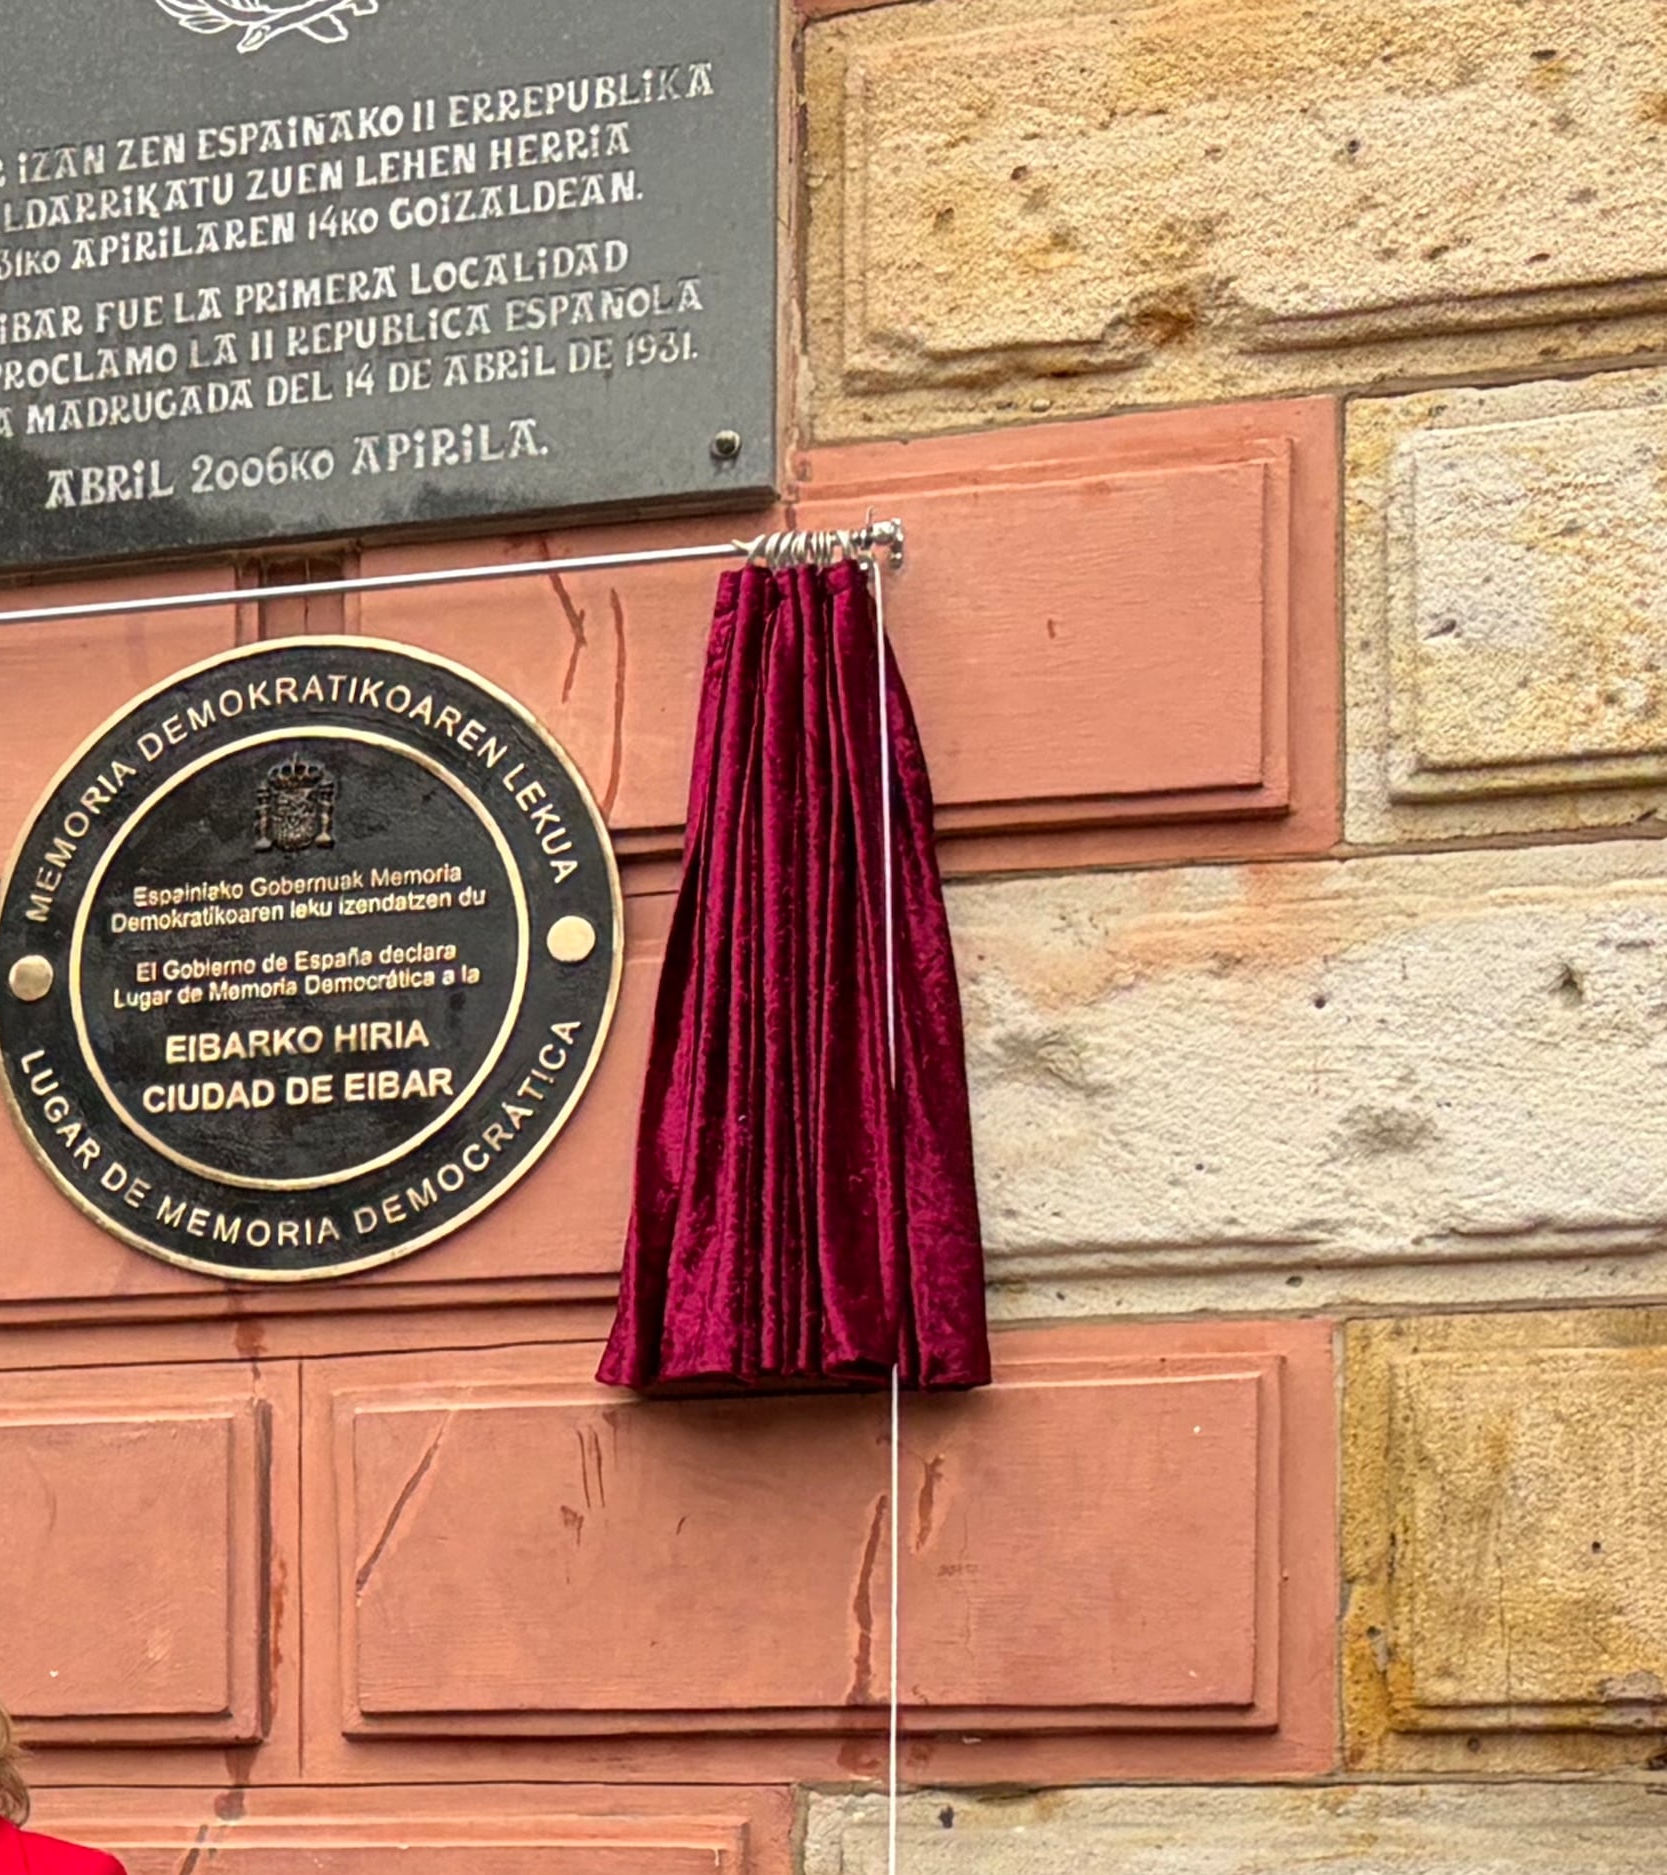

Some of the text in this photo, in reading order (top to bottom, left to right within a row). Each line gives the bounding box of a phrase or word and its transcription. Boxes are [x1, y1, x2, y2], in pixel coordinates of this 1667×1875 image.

[117, 132, 185, 171] ZEN
[412, 98, 436, 132] II
[246, 159, 343, 201] ZUEN
[356, 143, 476, 187] LEHEN
[95, 296, 164, 334] FUE
[174, 287, 223, 324] LA
[188, 333, 238, 369] LA
[251, 329, 273, 362] II
[506, 277, 703, 332] ESPAÑOLA
[26, 379, 253, 435] MADRUGADA
[267, 370, 333, 407] DEL
[346, 363, 375, 397] 14
[388, 358, 431, 392] DE
[568, 336, 613, 373] DE
[25, 674, 579, 923] MEMORIA DEMOKRATIKOAREN LEKUA
[133, 863, 462, 907] Espainiako Gobernuak Memoria
[111, 886, 486, 933] Demokratikoaren leku izendatzen du
[136, 942, 457, 982] El Gobierno de España declara
[114, 964, 480, 1012] Lugar de Memoria Democrática a la
[166, 1019, 430, 1064] EIBARKO HIRIA
[142, 1067, 454, 1114] CIUDAD DE EIBAR
[21, 1020, 582, 1247] LUGAR DE MEMORIA DEMOCRÁTICA
